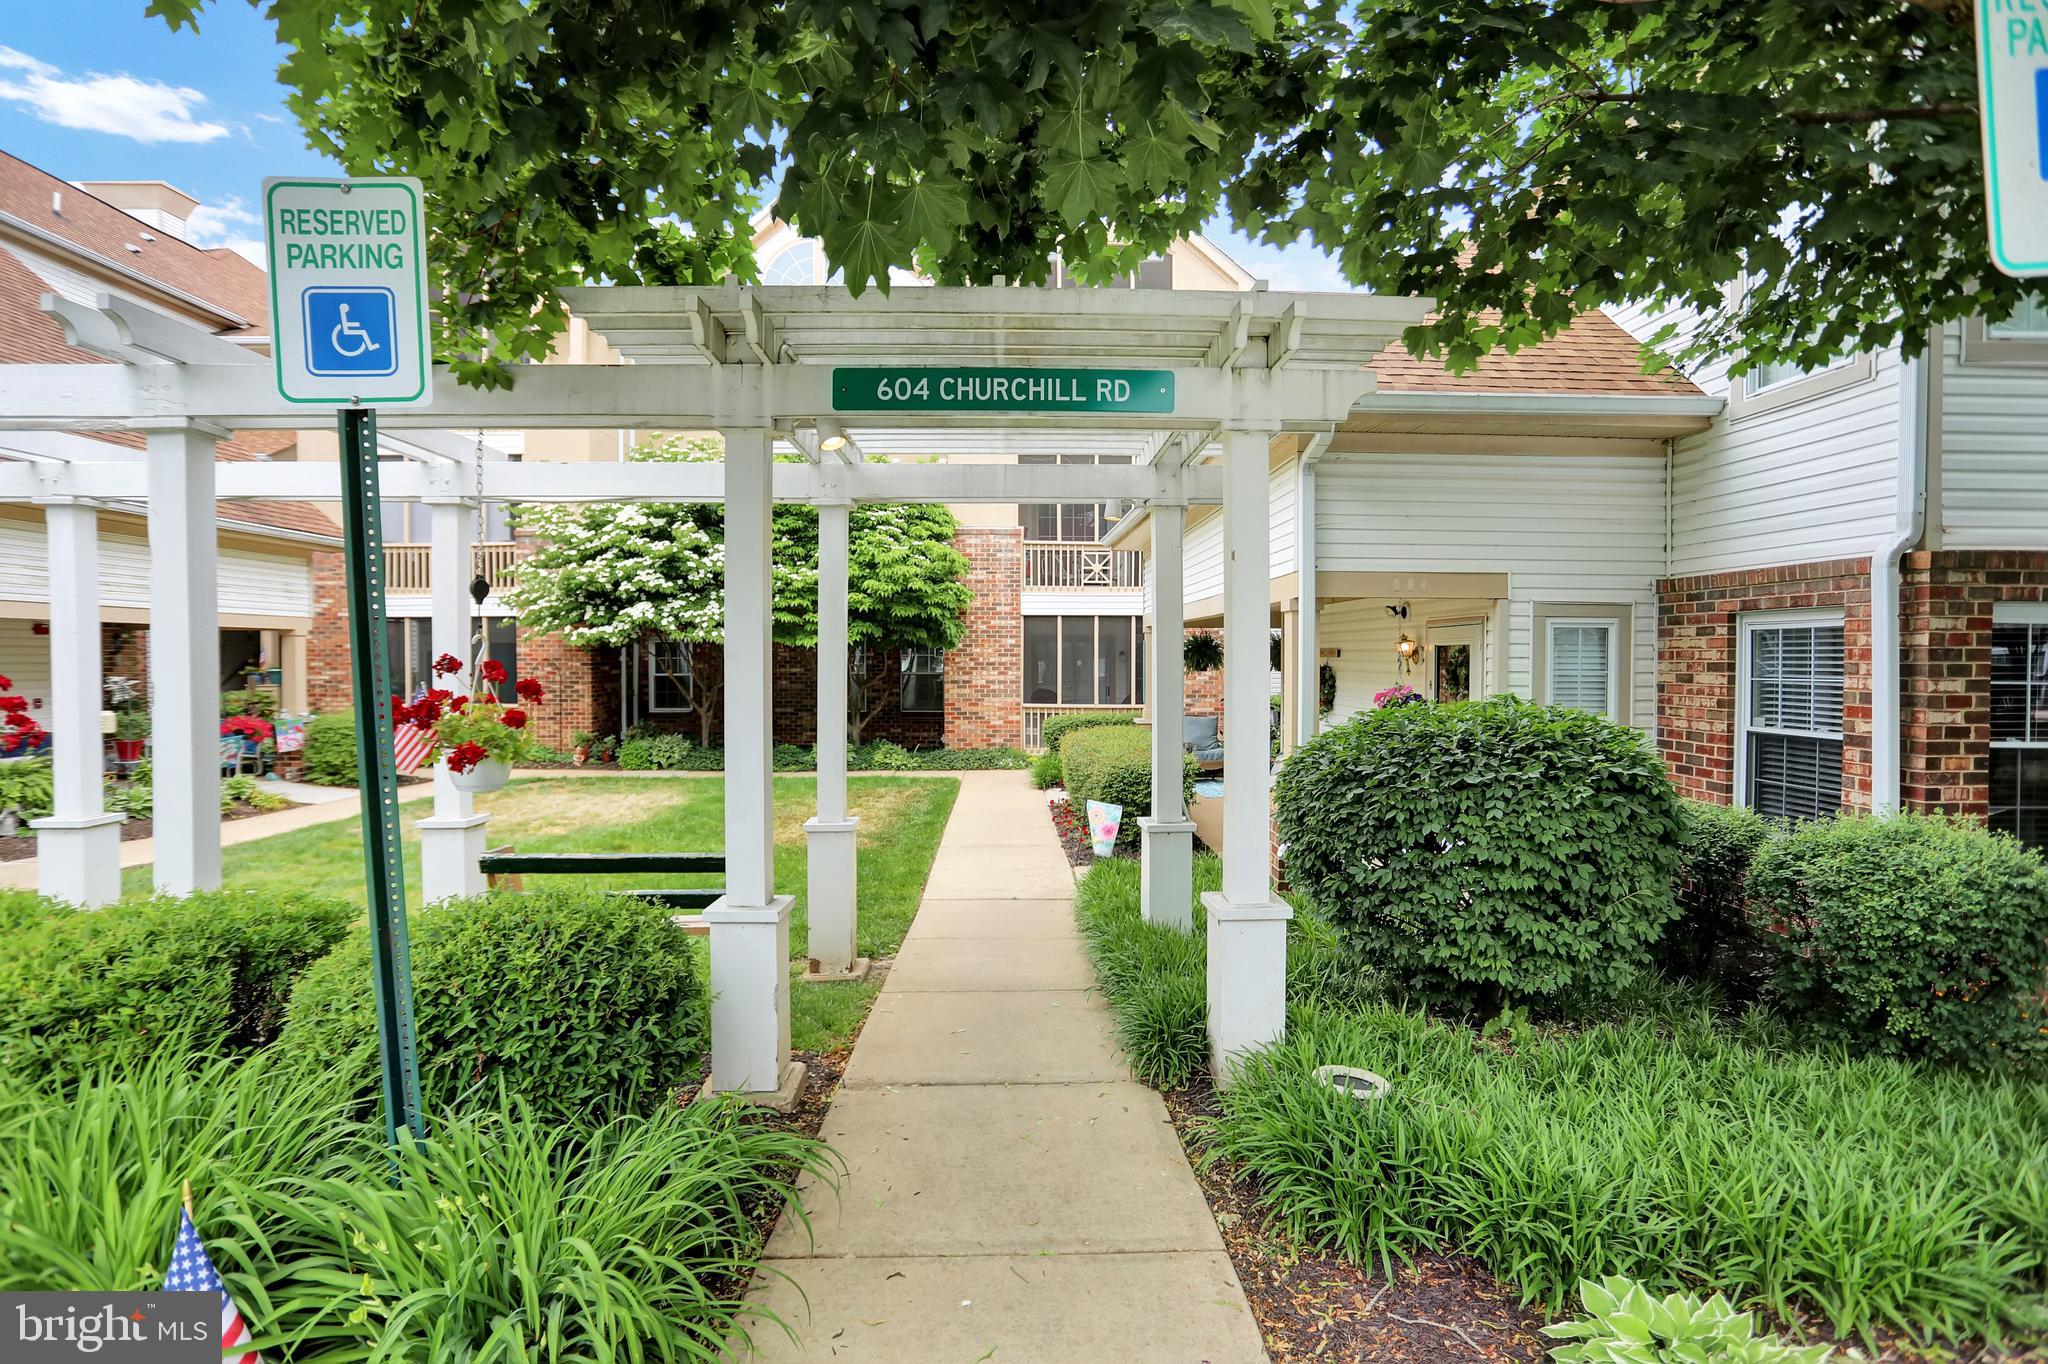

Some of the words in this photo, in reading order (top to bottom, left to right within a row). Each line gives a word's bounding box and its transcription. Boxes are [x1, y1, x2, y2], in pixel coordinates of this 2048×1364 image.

[279, 208, 407, 236] RESERVED
[286, 243, 404, 269] PARKING
[876, 377, 930, 400] 604
[939, 377, 1087, 402] CHURCHILL
[1096, 379, 1131, 402] RD
